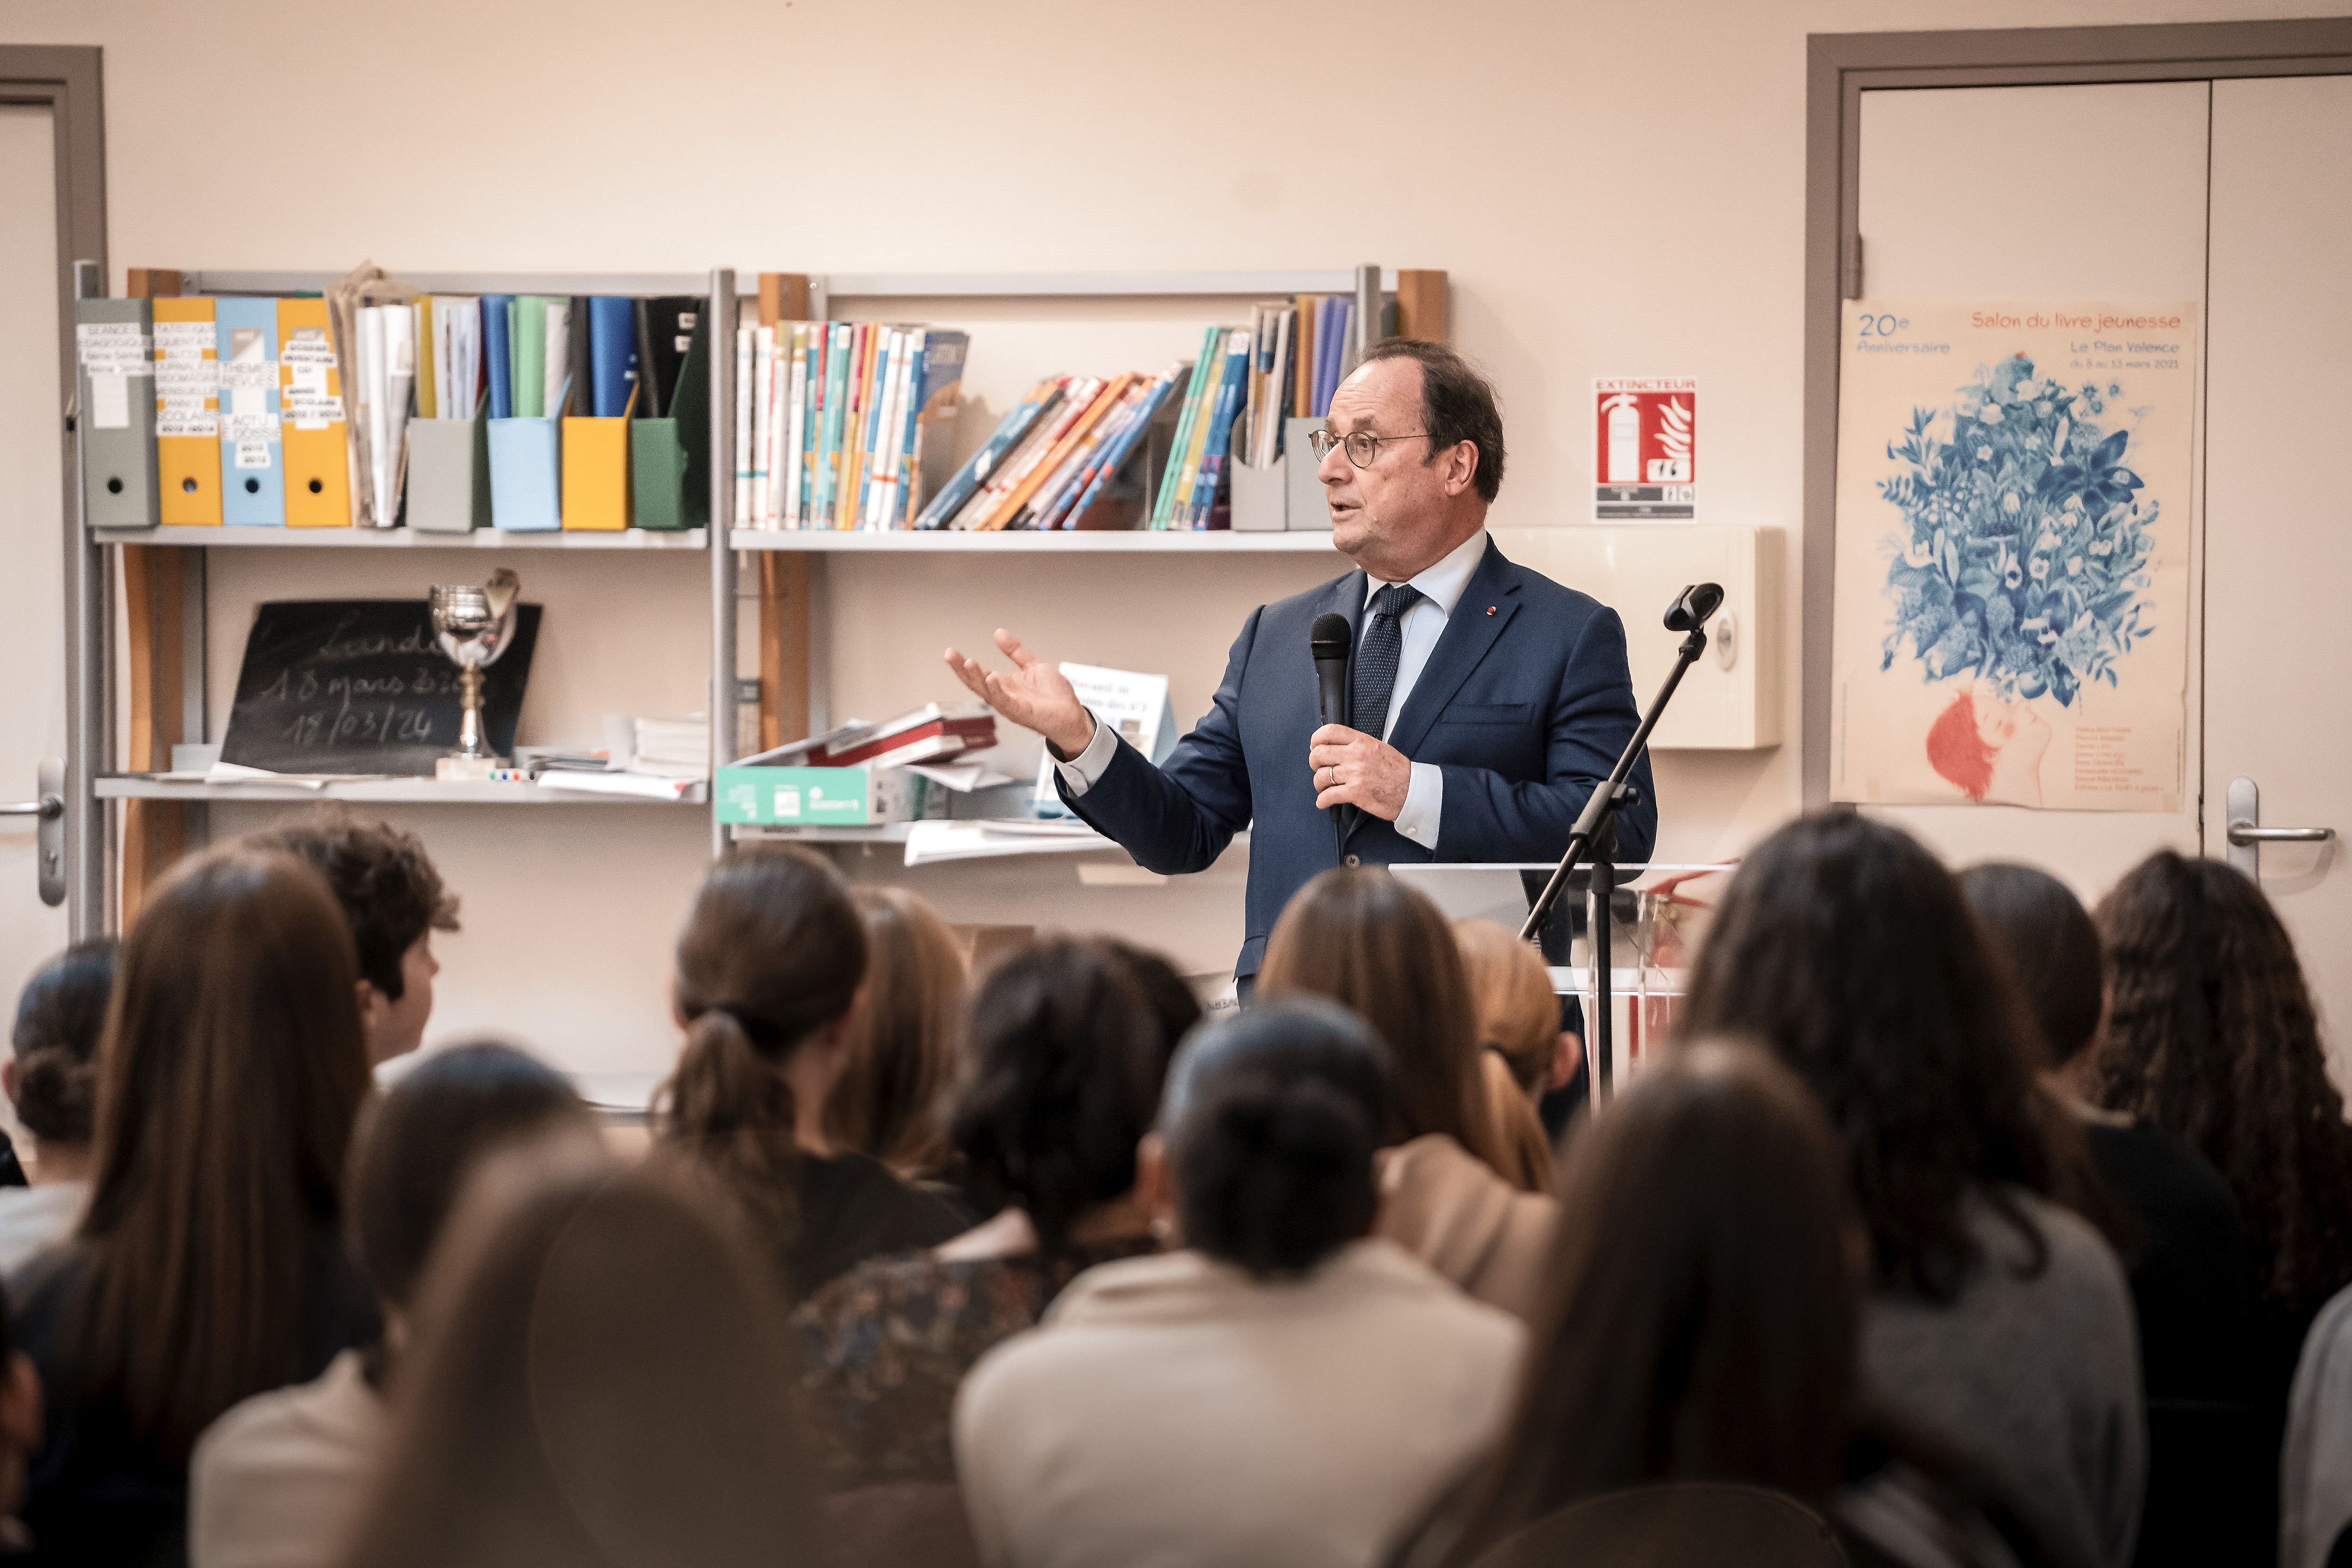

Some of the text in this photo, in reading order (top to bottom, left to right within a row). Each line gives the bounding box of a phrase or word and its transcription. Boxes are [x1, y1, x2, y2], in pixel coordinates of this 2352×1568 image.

[1972, 311, 2181, 333] Salon du livre jeunesse
[1857, 339, 1950, 354] Anniversaire
[2070, 341, 2180, 353] Le Plan Valence
[2070, 359, 2083, 369] du
[2153, 359, 2179, 368] 2021
[1596, 379, 1696, 390] EXTINCTEUR
